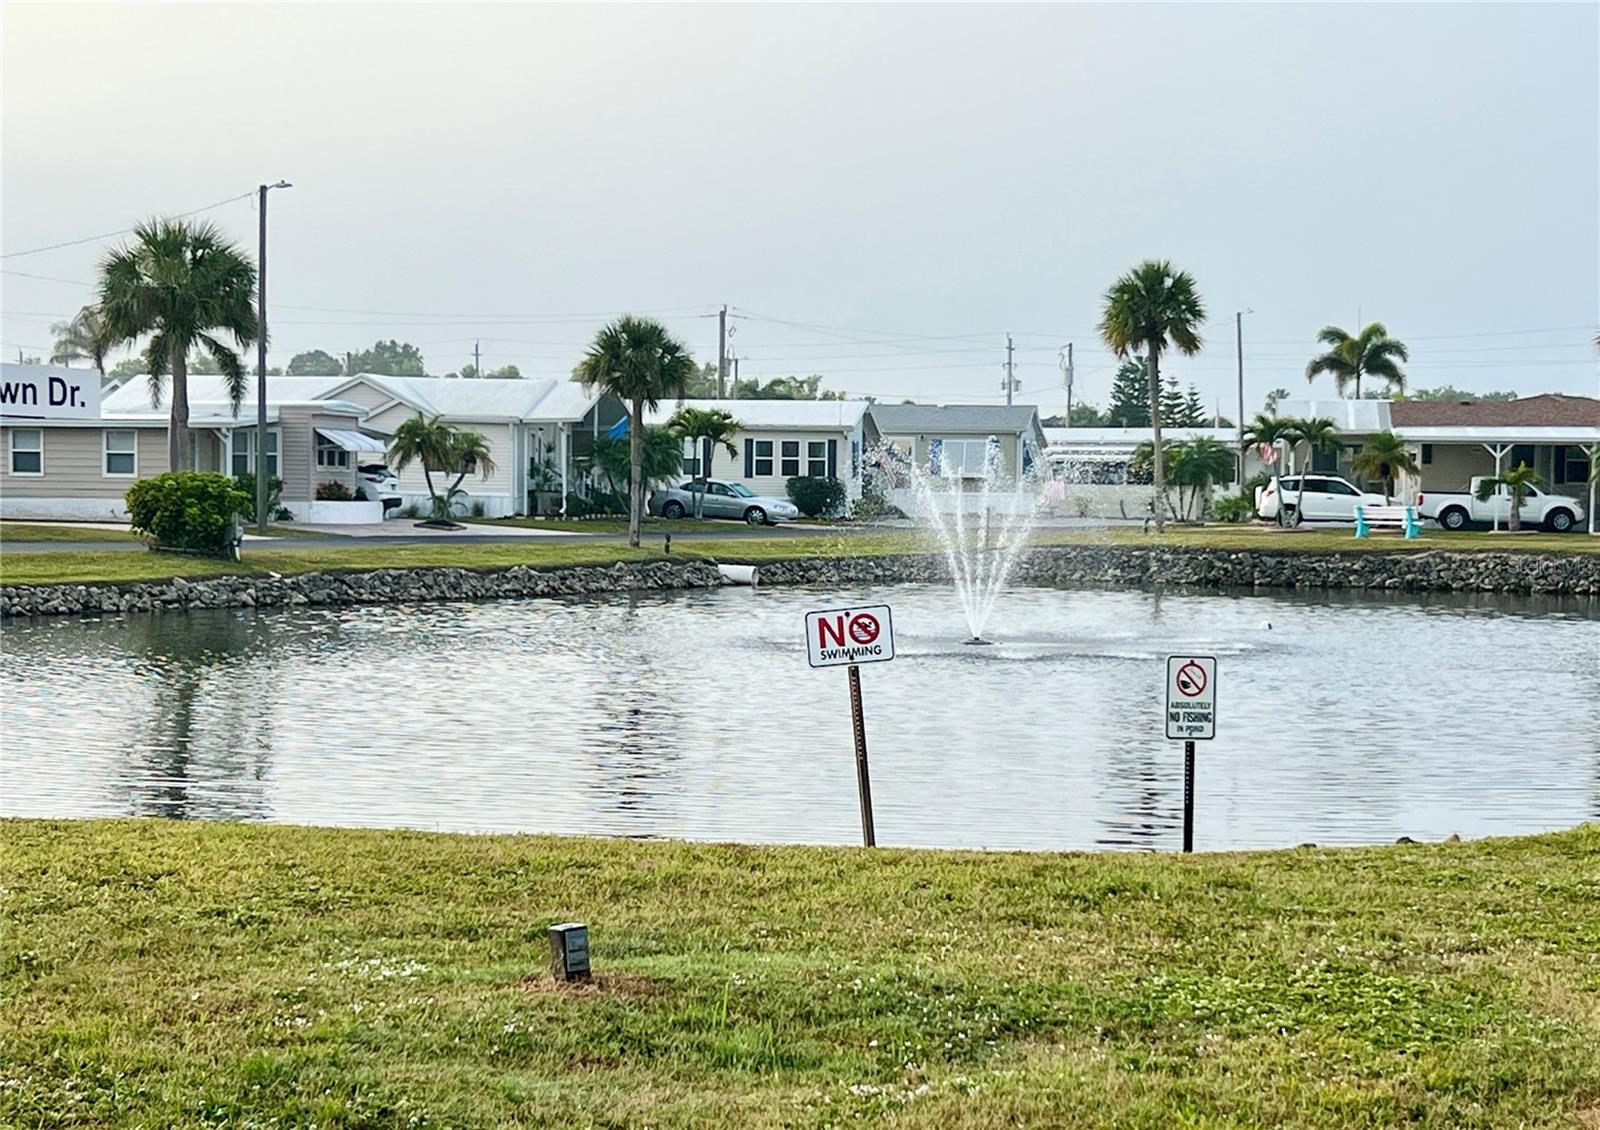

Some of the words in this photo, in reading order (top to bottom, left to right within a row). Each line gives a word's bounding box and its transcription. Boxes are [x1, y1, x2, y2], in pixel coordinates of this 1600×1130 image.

[0, 382, 37, 405] wn
[48, 376, 86, 408] Dr.
[817, 612, 880, 649] NO
[820, 644, 882, 660] SWIMMING
[1170, 701, 1212, 709] ABSOLUTELY
[1169, 711, 1180, 722] NO
[1182, 711, 1212, 723] FISHING
[1185, 725, 1204, 733] POND
